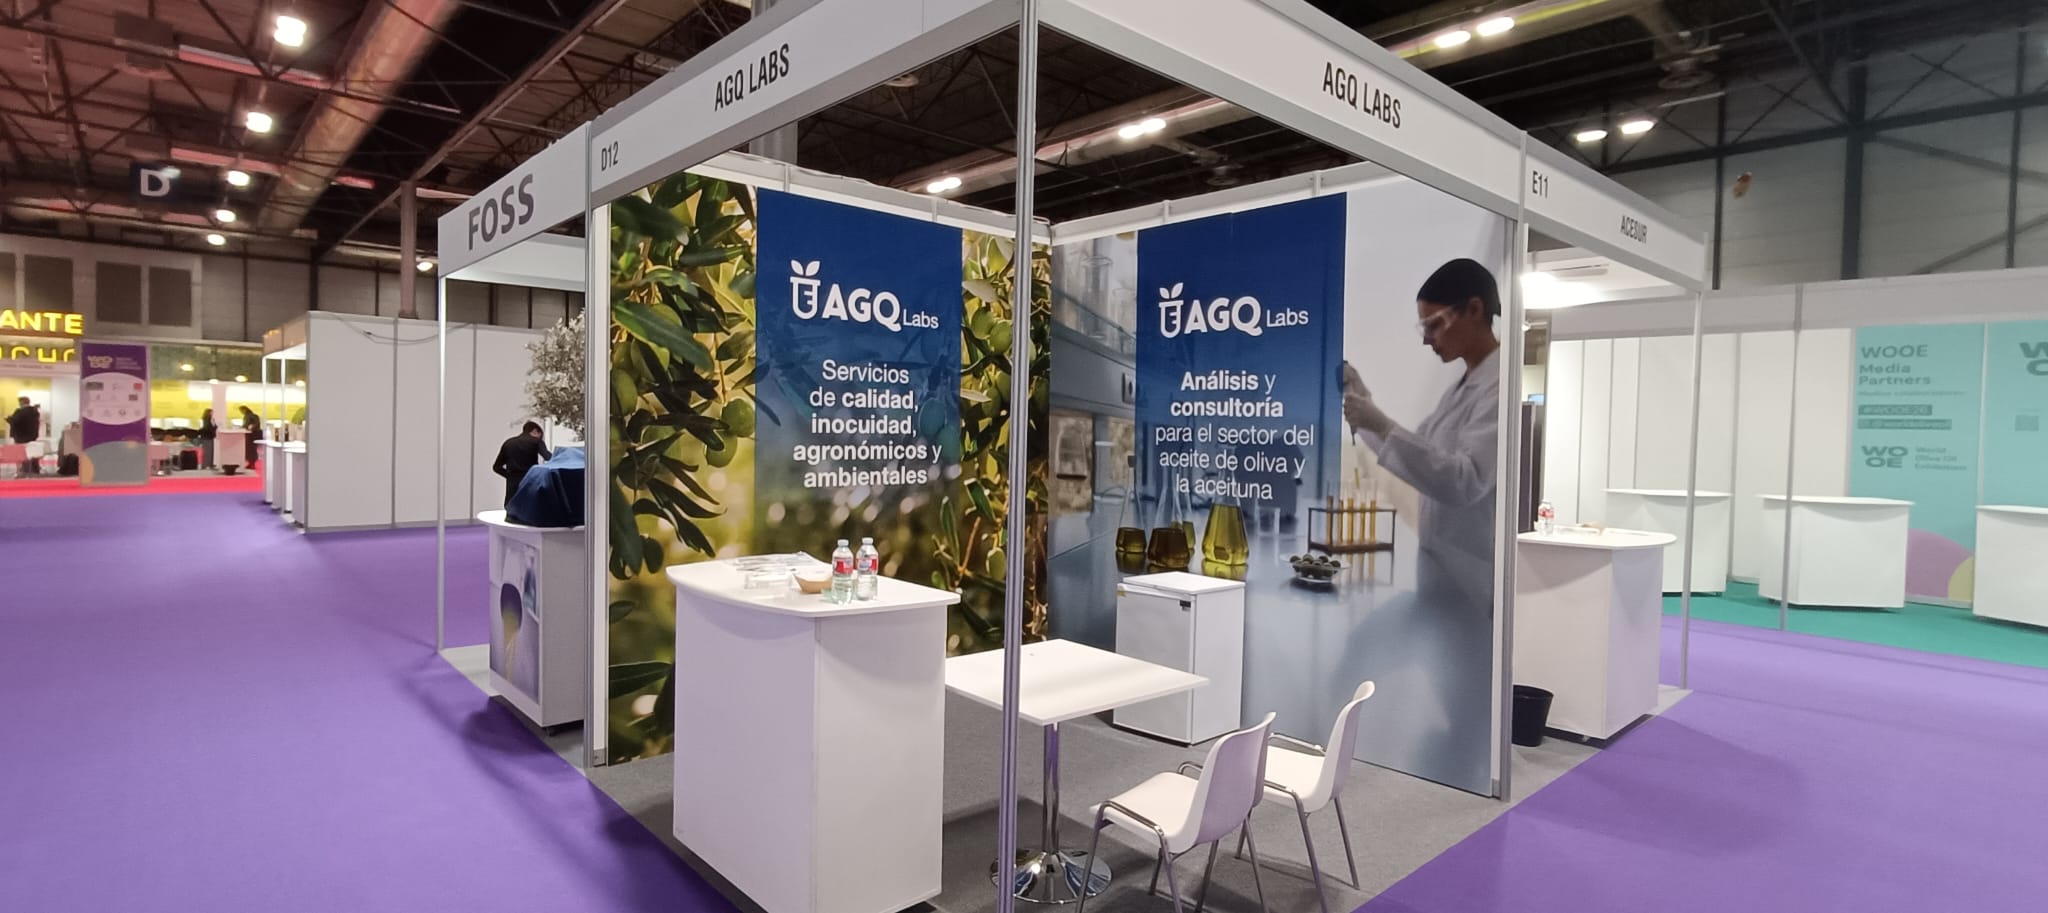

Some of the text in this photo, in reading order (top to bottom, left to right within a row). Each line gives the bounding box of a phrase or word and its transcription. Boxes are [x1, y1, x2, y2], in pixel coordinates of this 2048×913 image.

[714, 43, 790, 111] AGQ LABS
[1323, 61, 1402, 129] AGQ LABS
[601, 141, 619, 171] D12
[141, 168, 170, 197] D
[1532, 170, 1549, 198] E11
[468, 173, 535, 251] FOSS
[1621, 214, 1648, 244] ACESUR
[822, 283, 940, 332] AGQ Labs
[1184, 295, 1310, 336] AGQ Labs
[1861, 344, 1929, 359] WOOE
[822, 359, 910, 384] Servicios
[1859, 363, 1911, 374] Media
[1859, 375, 1931, 385] Partners
[1180, 369, 1276, 395] Análisis y
[809, 386, 919, 413] de calidad,
[1170, 396, 1284, 418] consultoría
[811, 412, 917, 437] inocuidad,
[1155, 423, 1314, 446] para el sector del
[793, 439, 943, 465] agronómicos y
[1159, 448, 1306, 479] aceite de oliva y
[803, 466, 928, 488] ambientales
[1175, 473, 1273, 499] la aceituna
